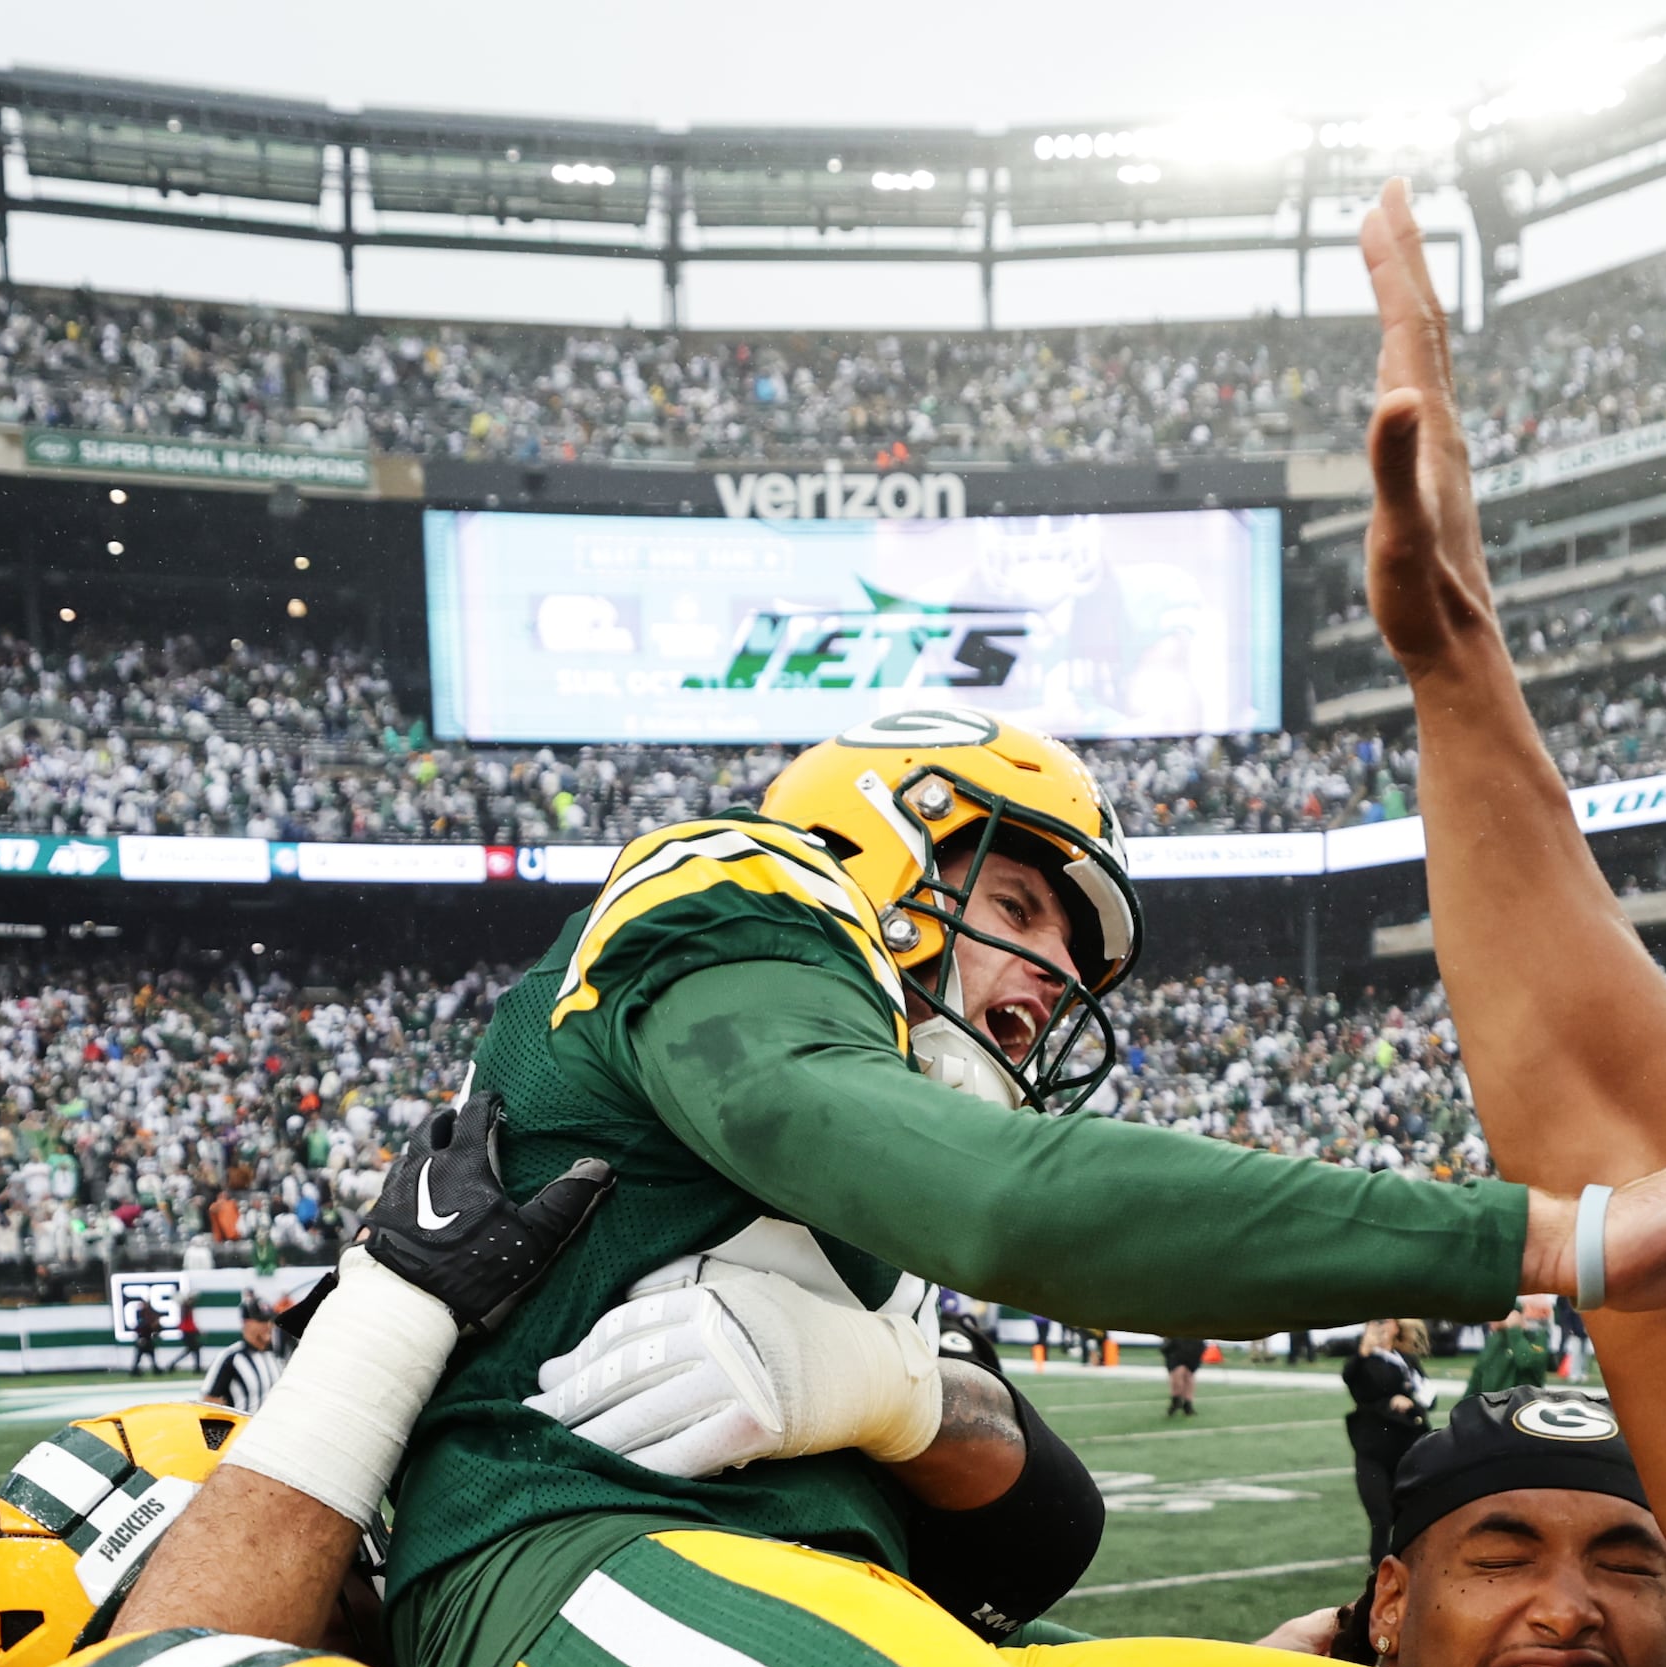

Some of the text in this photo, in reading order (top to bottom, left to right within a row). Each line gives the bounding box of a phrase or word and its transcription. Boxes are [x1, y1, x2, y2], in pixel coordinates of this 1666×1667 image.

[79, 438, 150, 466] SUPER
[152, 445, 221, 470] BOWL
[239, 452, 367, 481] CHAMPIONS
[714, 459, 965, 519] verizon
[1515, 1400, 1617, 1440] G
[98, 1497, 166, 1563] PACKERS
